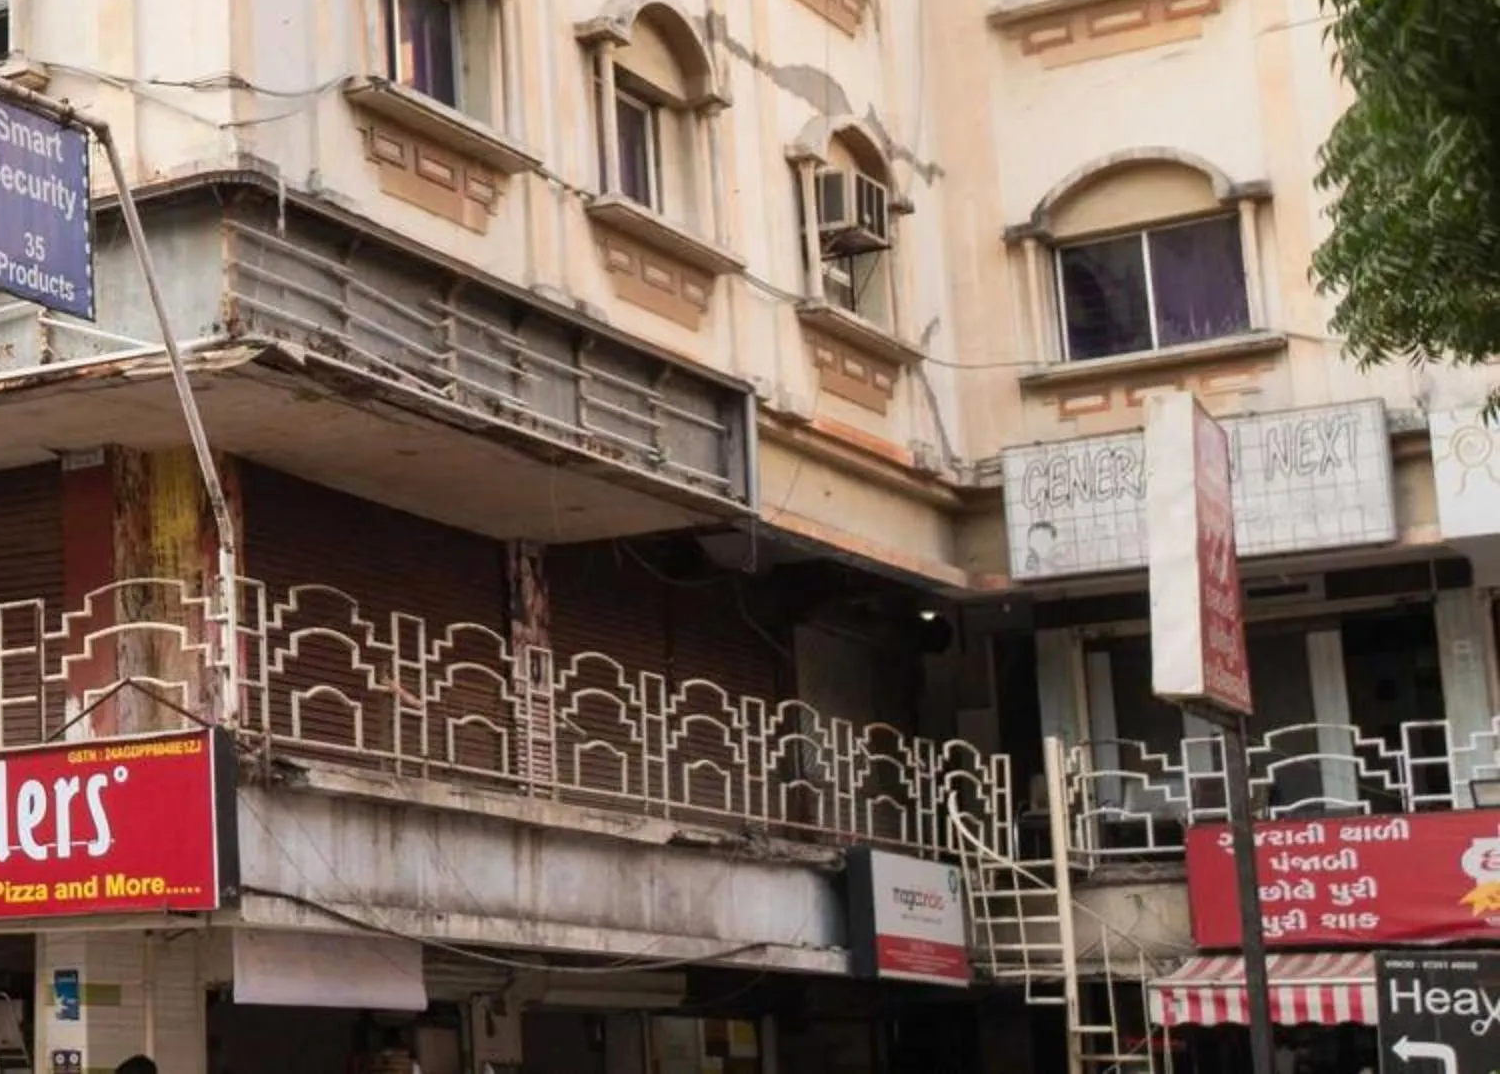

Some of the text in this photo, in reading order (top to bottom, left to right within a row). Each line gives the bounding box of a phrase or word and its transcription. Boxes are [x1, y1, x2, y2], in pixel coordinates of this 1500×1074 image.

[23, 232, 46, 262] 35
[1262, 413, 1360, 483] NEXT
[55, 876, 100, 901] and
